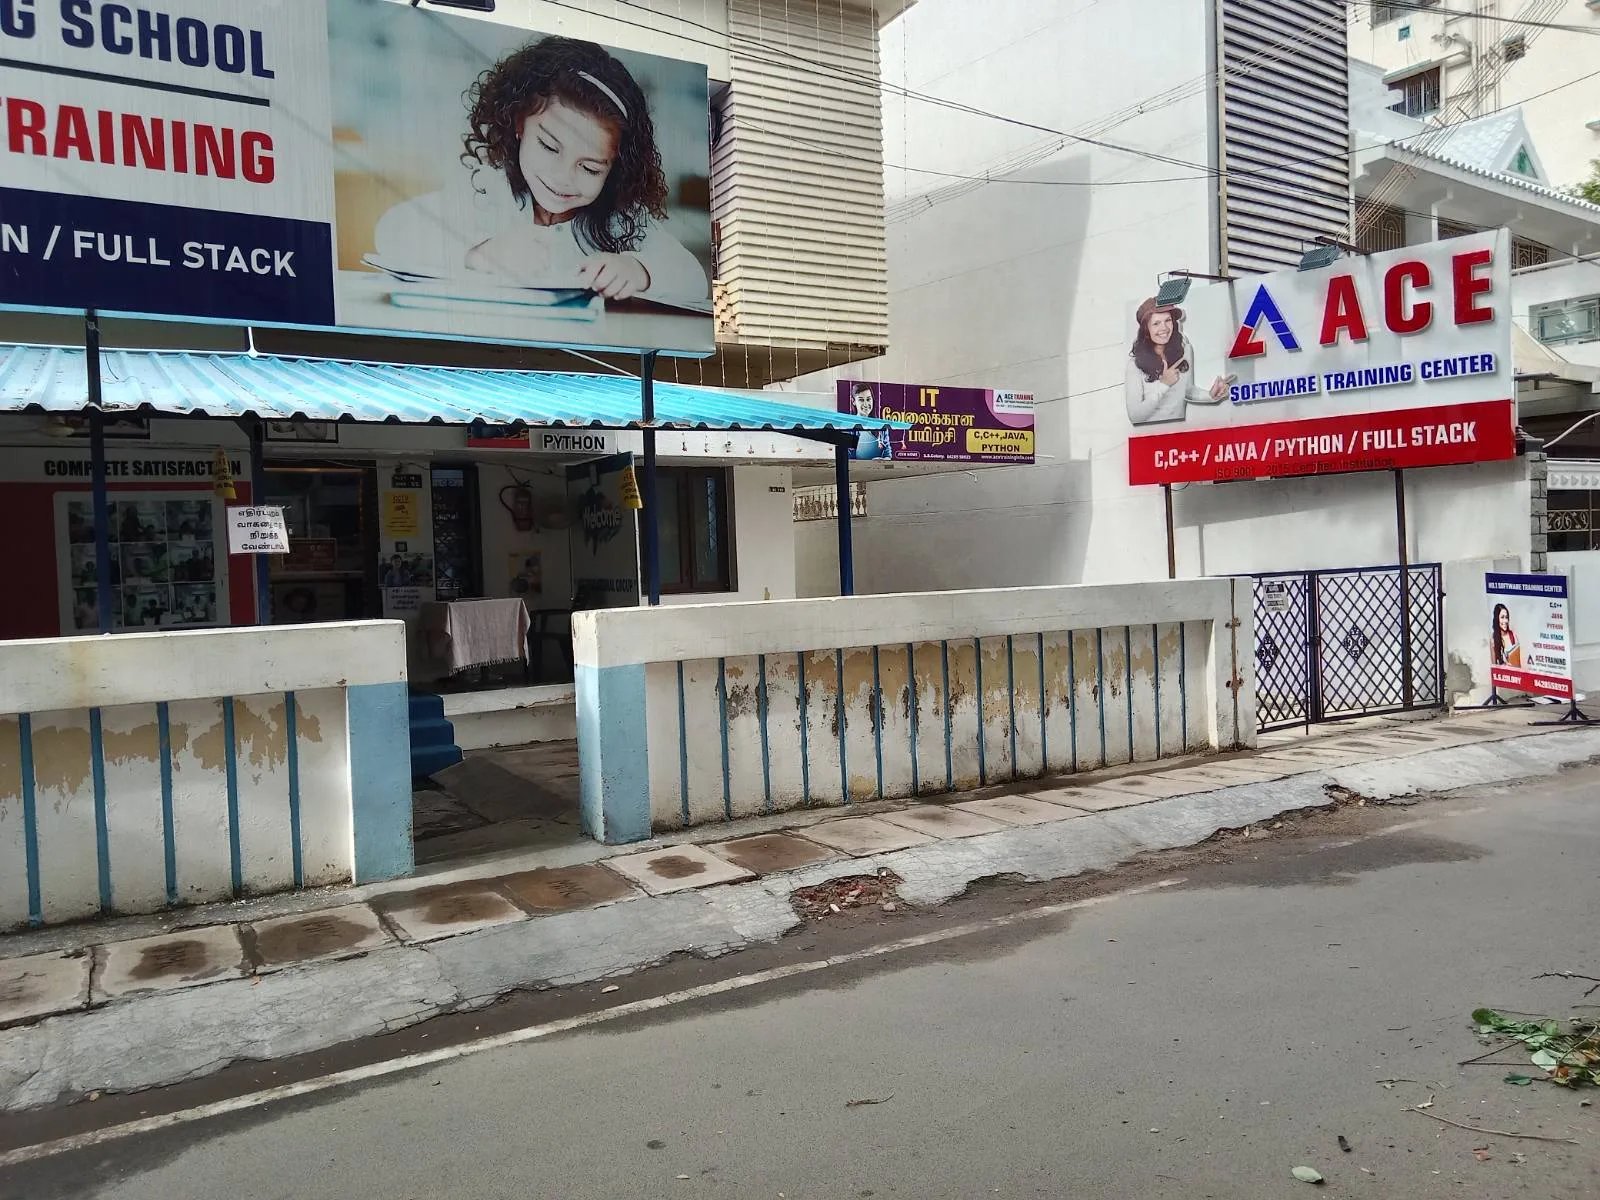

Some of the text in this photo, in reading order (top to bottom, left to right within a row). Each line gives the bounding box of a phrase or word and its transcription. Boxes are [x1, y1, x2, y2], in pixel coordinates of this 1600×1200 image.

[60, 0, 275, 79] SCHOOL
[0, 97, 275, 184] RAINING
[43, 225, 61, 260] /
[73, 230, 171, 267] FULL
[182, 241, 297, 278] STACK
[1319, 249, 1494, 346] ACE
[920, 388, 940, 407] IT
[1229, 353, 1495, 402] SOFTWARE TRAINING CENTER
[543, 434, 605, 450] PYTHON
[982, 444, 1020, 453] PYTHON
[1154, 421, 1477, 471] C,C++ / JAVA / PYTHON / FULL STACK
[44, 459, 129, 477] COMPETE
[1544, 585, 1563, 593] CENTER
